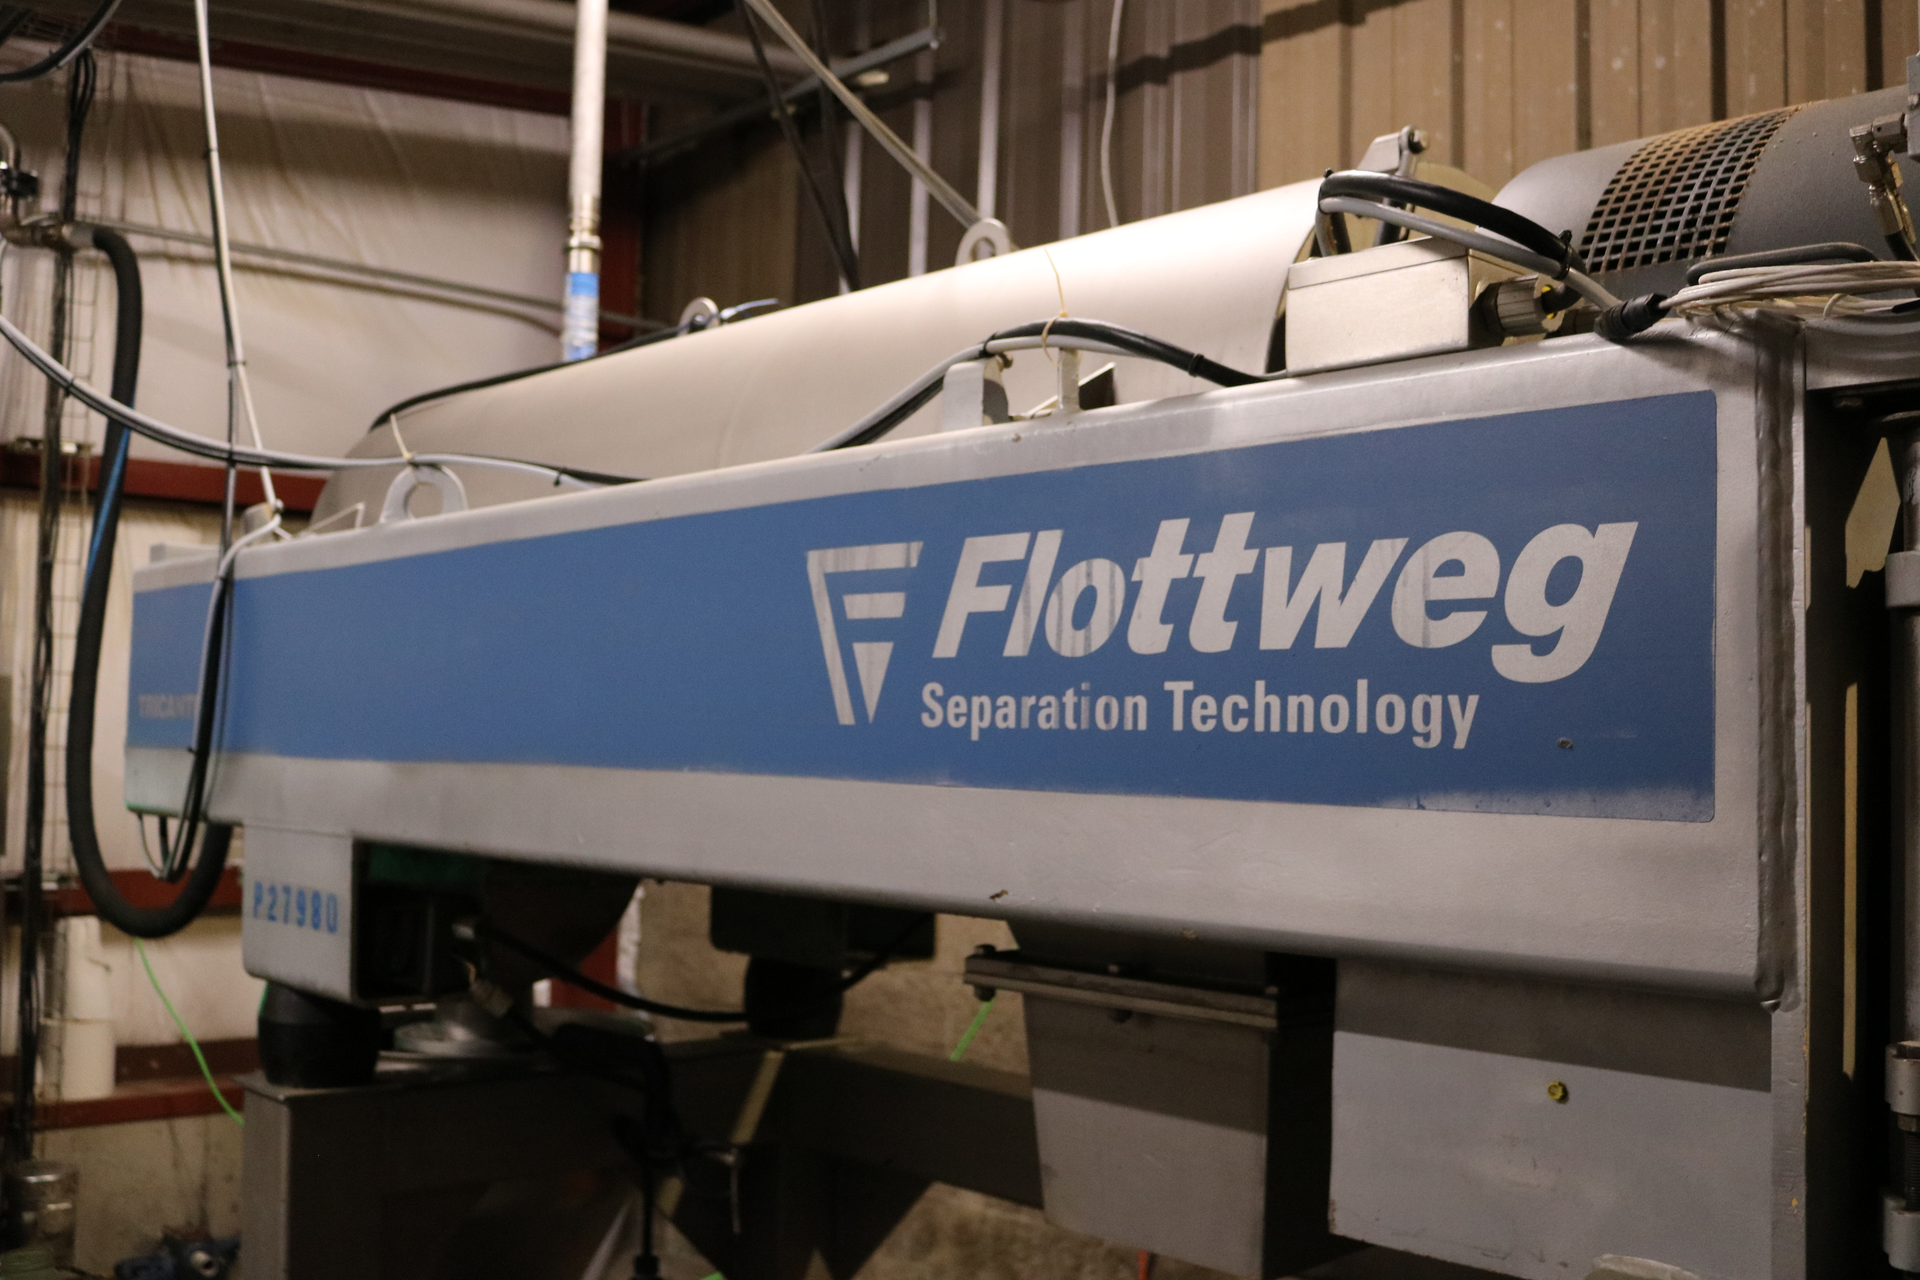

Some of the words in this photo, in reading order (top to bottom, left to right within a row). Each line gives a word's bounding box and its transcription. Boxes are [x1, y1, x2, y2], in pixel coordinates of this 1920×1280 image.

[932, 511, 1639, 684] Flottweg
[921, 682, 1148, 742] Separation
[1163, 678, 1480, 749] Technology
[253, 881, 339, 934] P27980
